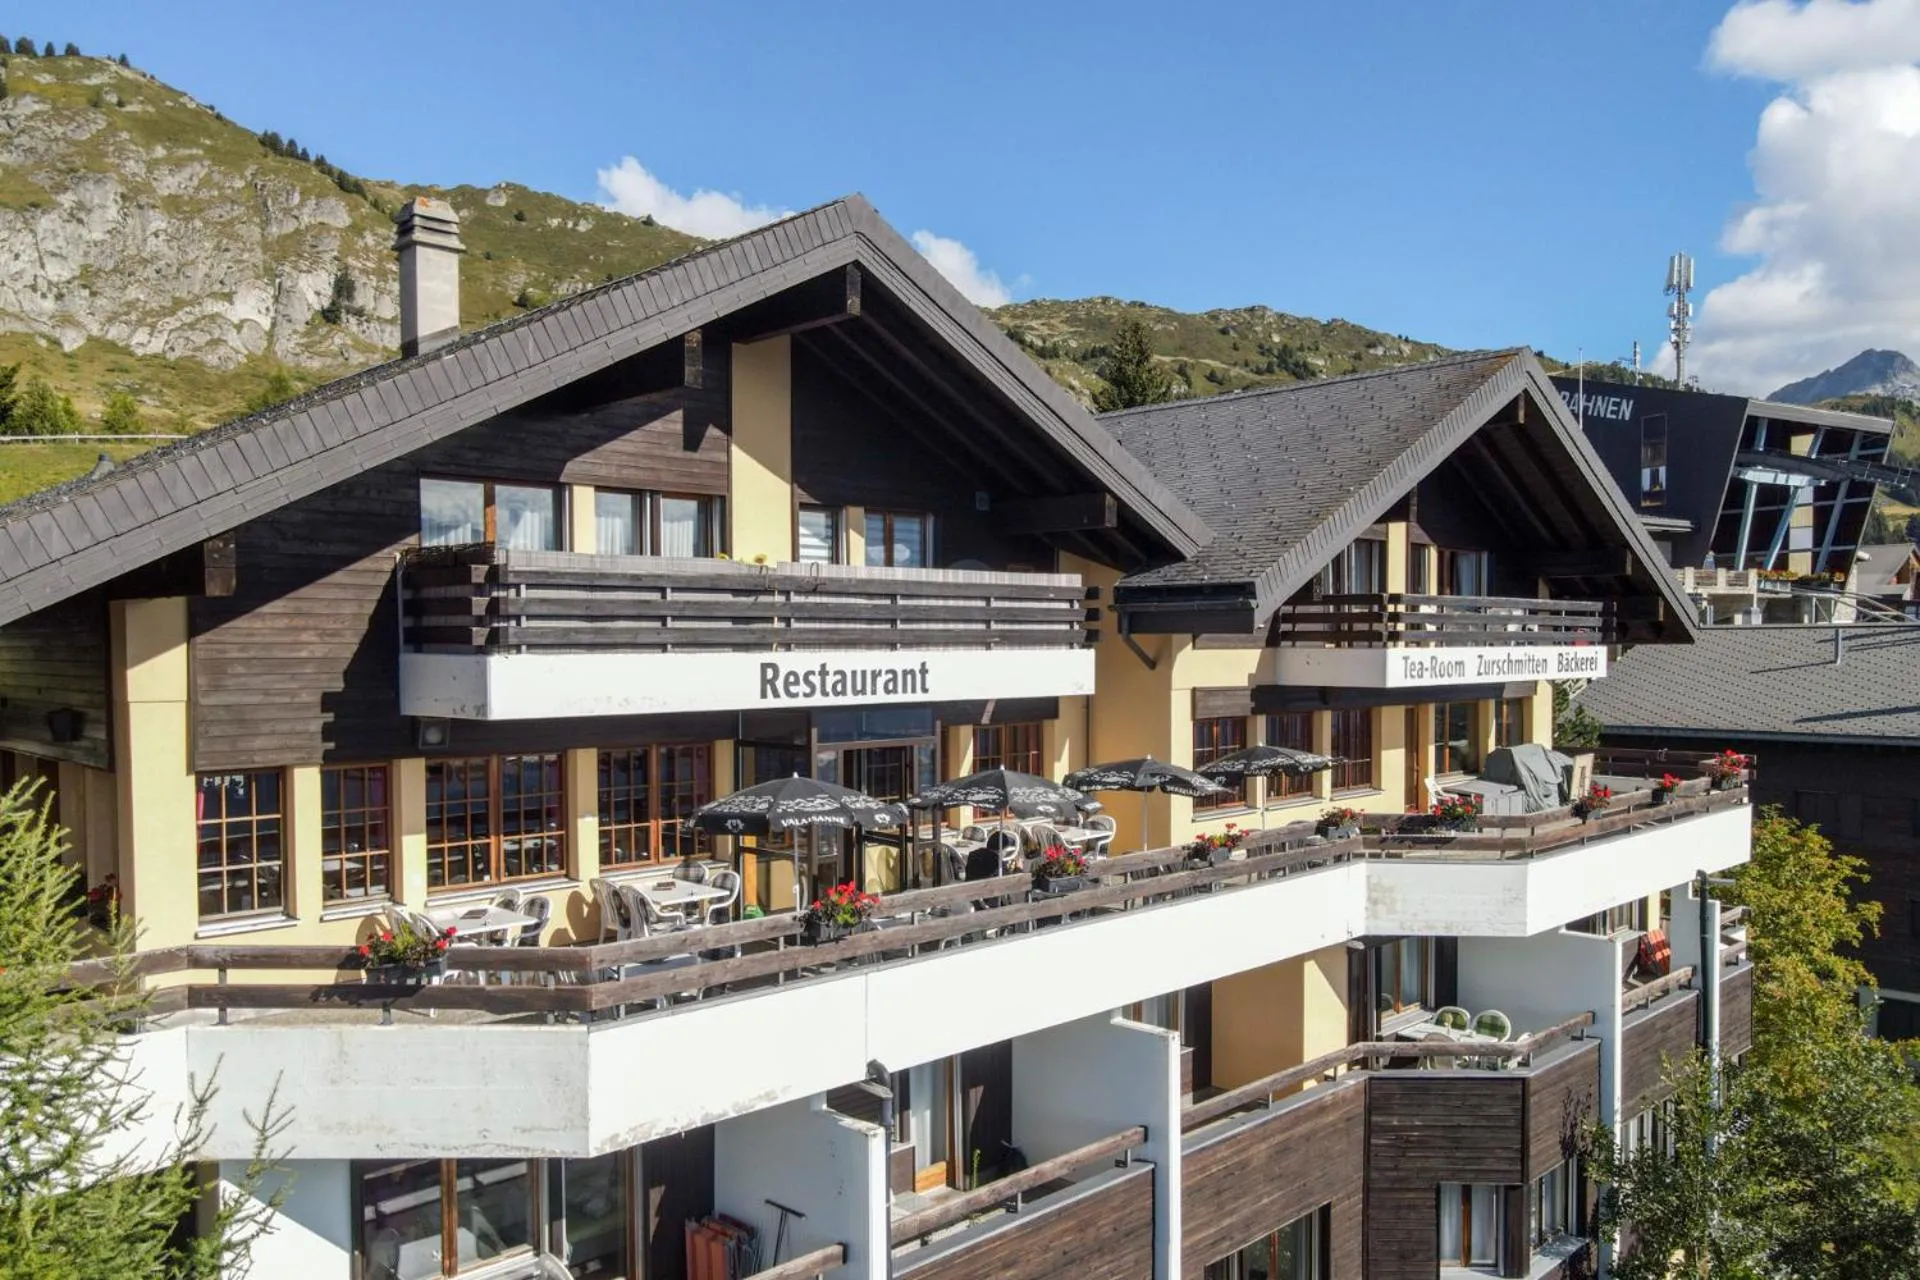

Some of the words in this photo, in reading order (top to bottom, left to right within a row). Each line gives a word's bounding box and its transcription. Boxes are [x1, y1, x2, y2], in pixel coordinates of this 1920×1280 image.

[759, 661, 929, 699] Restaurant
[1402, 655, 1465, 680] Tea-Room
[1476, 652, 1548, 677] Zurschmitten
[1557, 651, 1598, 673] Bäckerei
